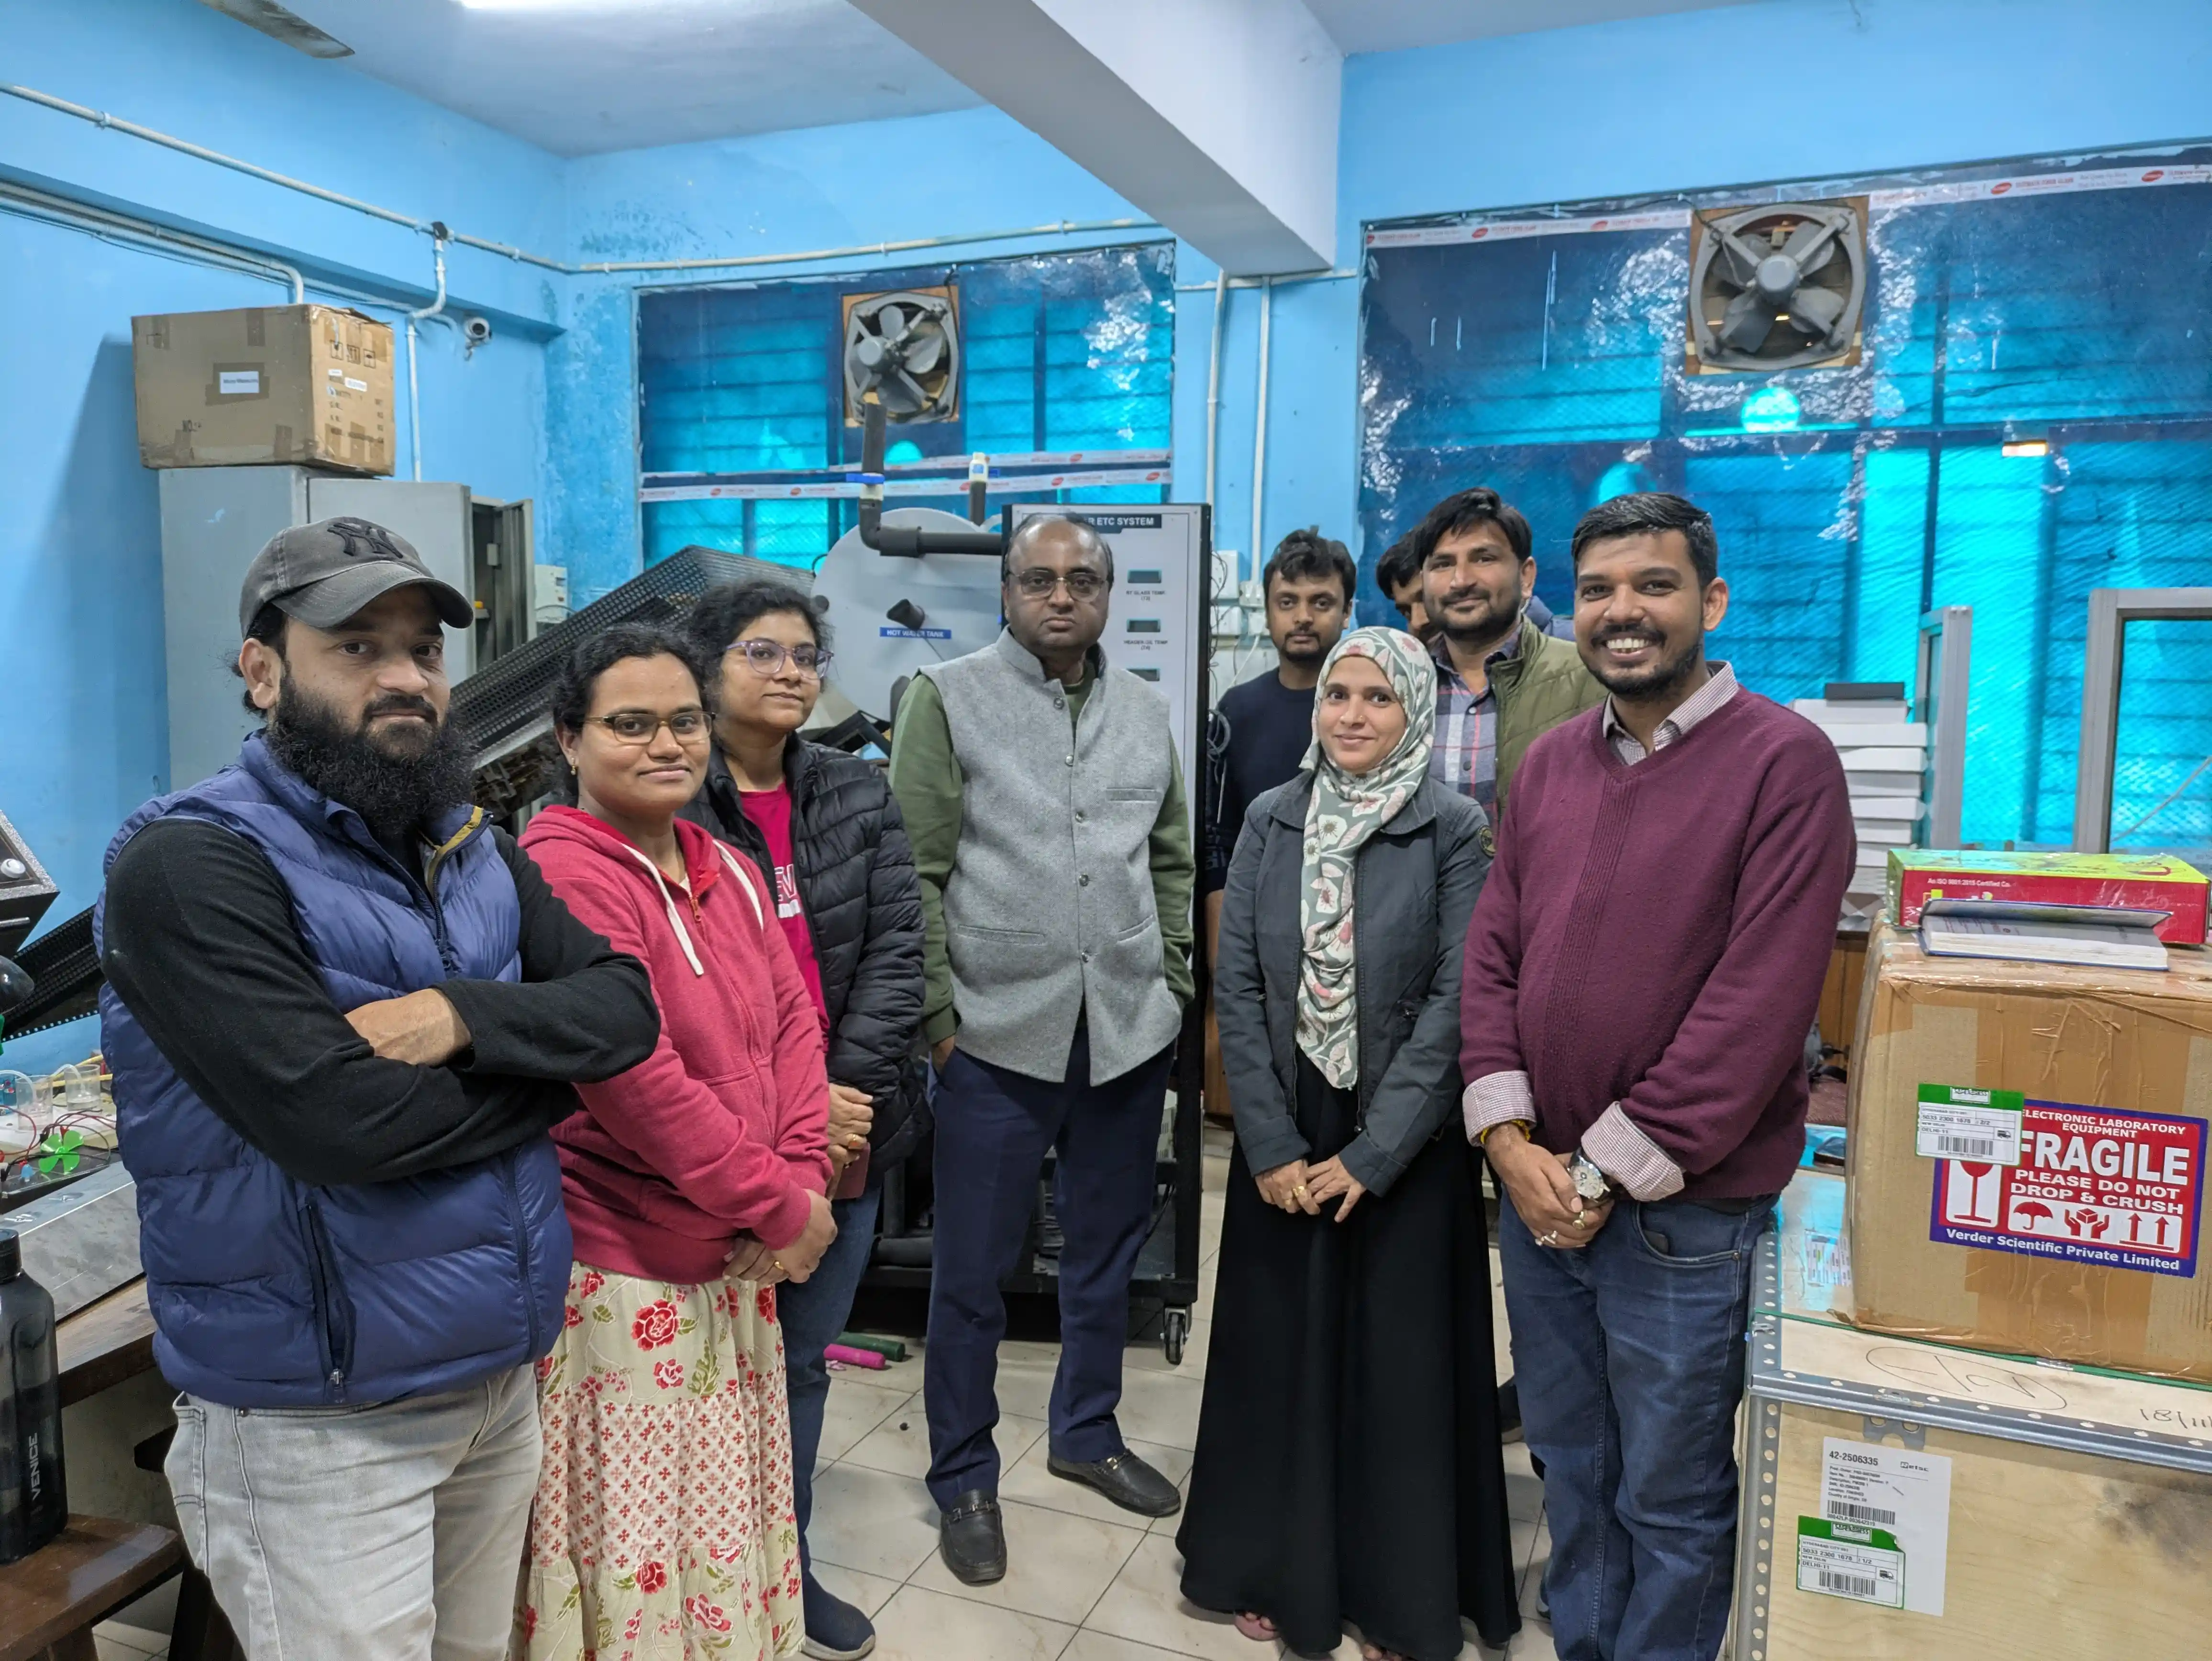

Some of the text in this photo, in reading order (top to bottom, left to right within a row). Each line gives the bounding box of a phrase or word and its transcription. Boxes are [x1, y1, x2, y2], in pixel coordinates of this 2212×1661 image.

[1097, 517, 1115, 526] ETC
[1117, 517, 1154, 526] SYSTEM
[2062, 1123, 2137, 1138] EQUIPMENT
[2100, 1118, 2186, 1135] LABORATORY
[2015, 1169, 2180, 1199] PLEASE DO NOT
[2011, 1183, 2183, 1215] DROP & CRUSH
[1947, 1228, 2179, 1270] Verder Scientific Private Limited
[29, 1432, 41, 1501] VENICE
[1829, 1451, 1879, 1466] 42-2506335
